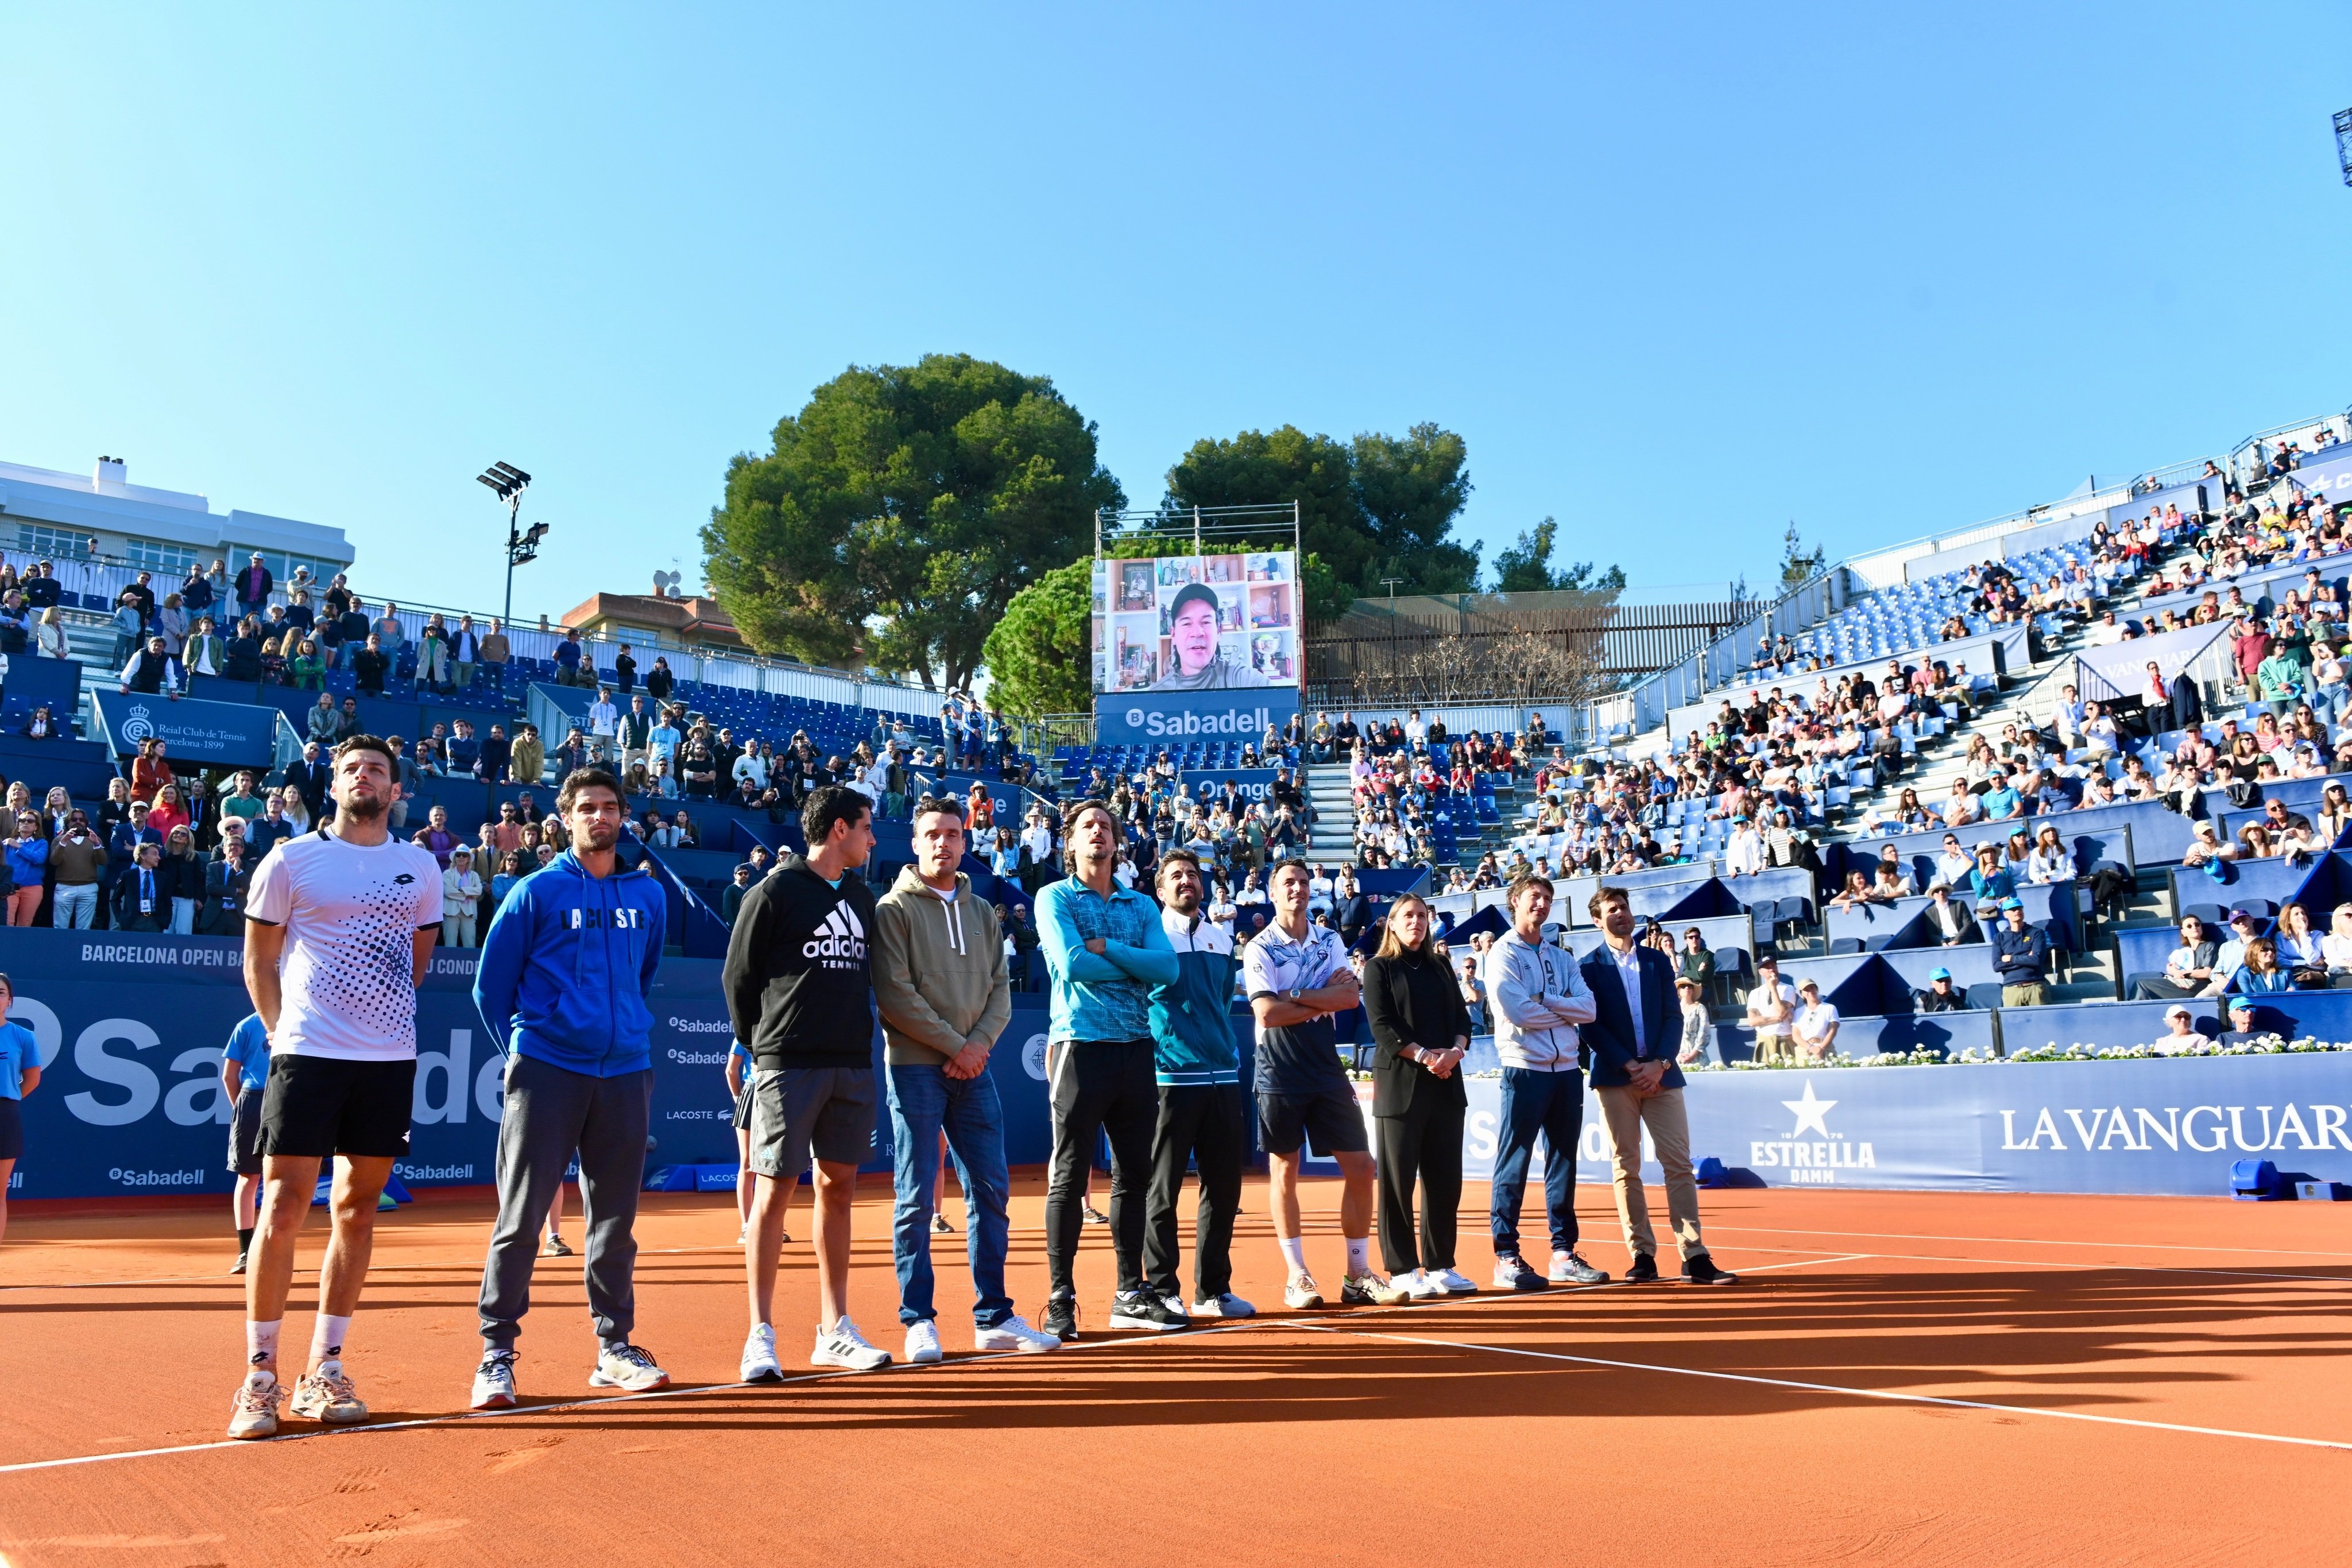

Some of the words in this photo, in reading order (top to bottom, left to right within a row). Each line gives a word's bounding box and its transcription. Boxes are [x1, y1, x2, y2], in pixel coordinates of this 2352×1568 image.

[1146, 707, 1268, 736] Sabadell
[158, 724, 181, 735] Reial
[183, 727, 205, 737] Club
[207, 729, 216, 738] de
[218, 730, 246, 742] Tennis
[1198, 780, 1272, 802] Ornge
[82, 944, 177, 965] BARCELONA
[182, 948, 222, 966] OPEN
[227, 950, 245, 967] BA
[803, 935, 867, 961] adida
[822, 960, 860, 971] TENNIS
[667, 1111, 713, 1120] LACOSTE
[1750, 1141, 1876, 1168] ESTRELLA
[122, 1169, 204, 1186] Sabadell
[403, 1164, 473, 1180] Sabadell
[701, 1174, 738, 1182] LACOS
[1790, 1169, 1834, 1183] DAMM
